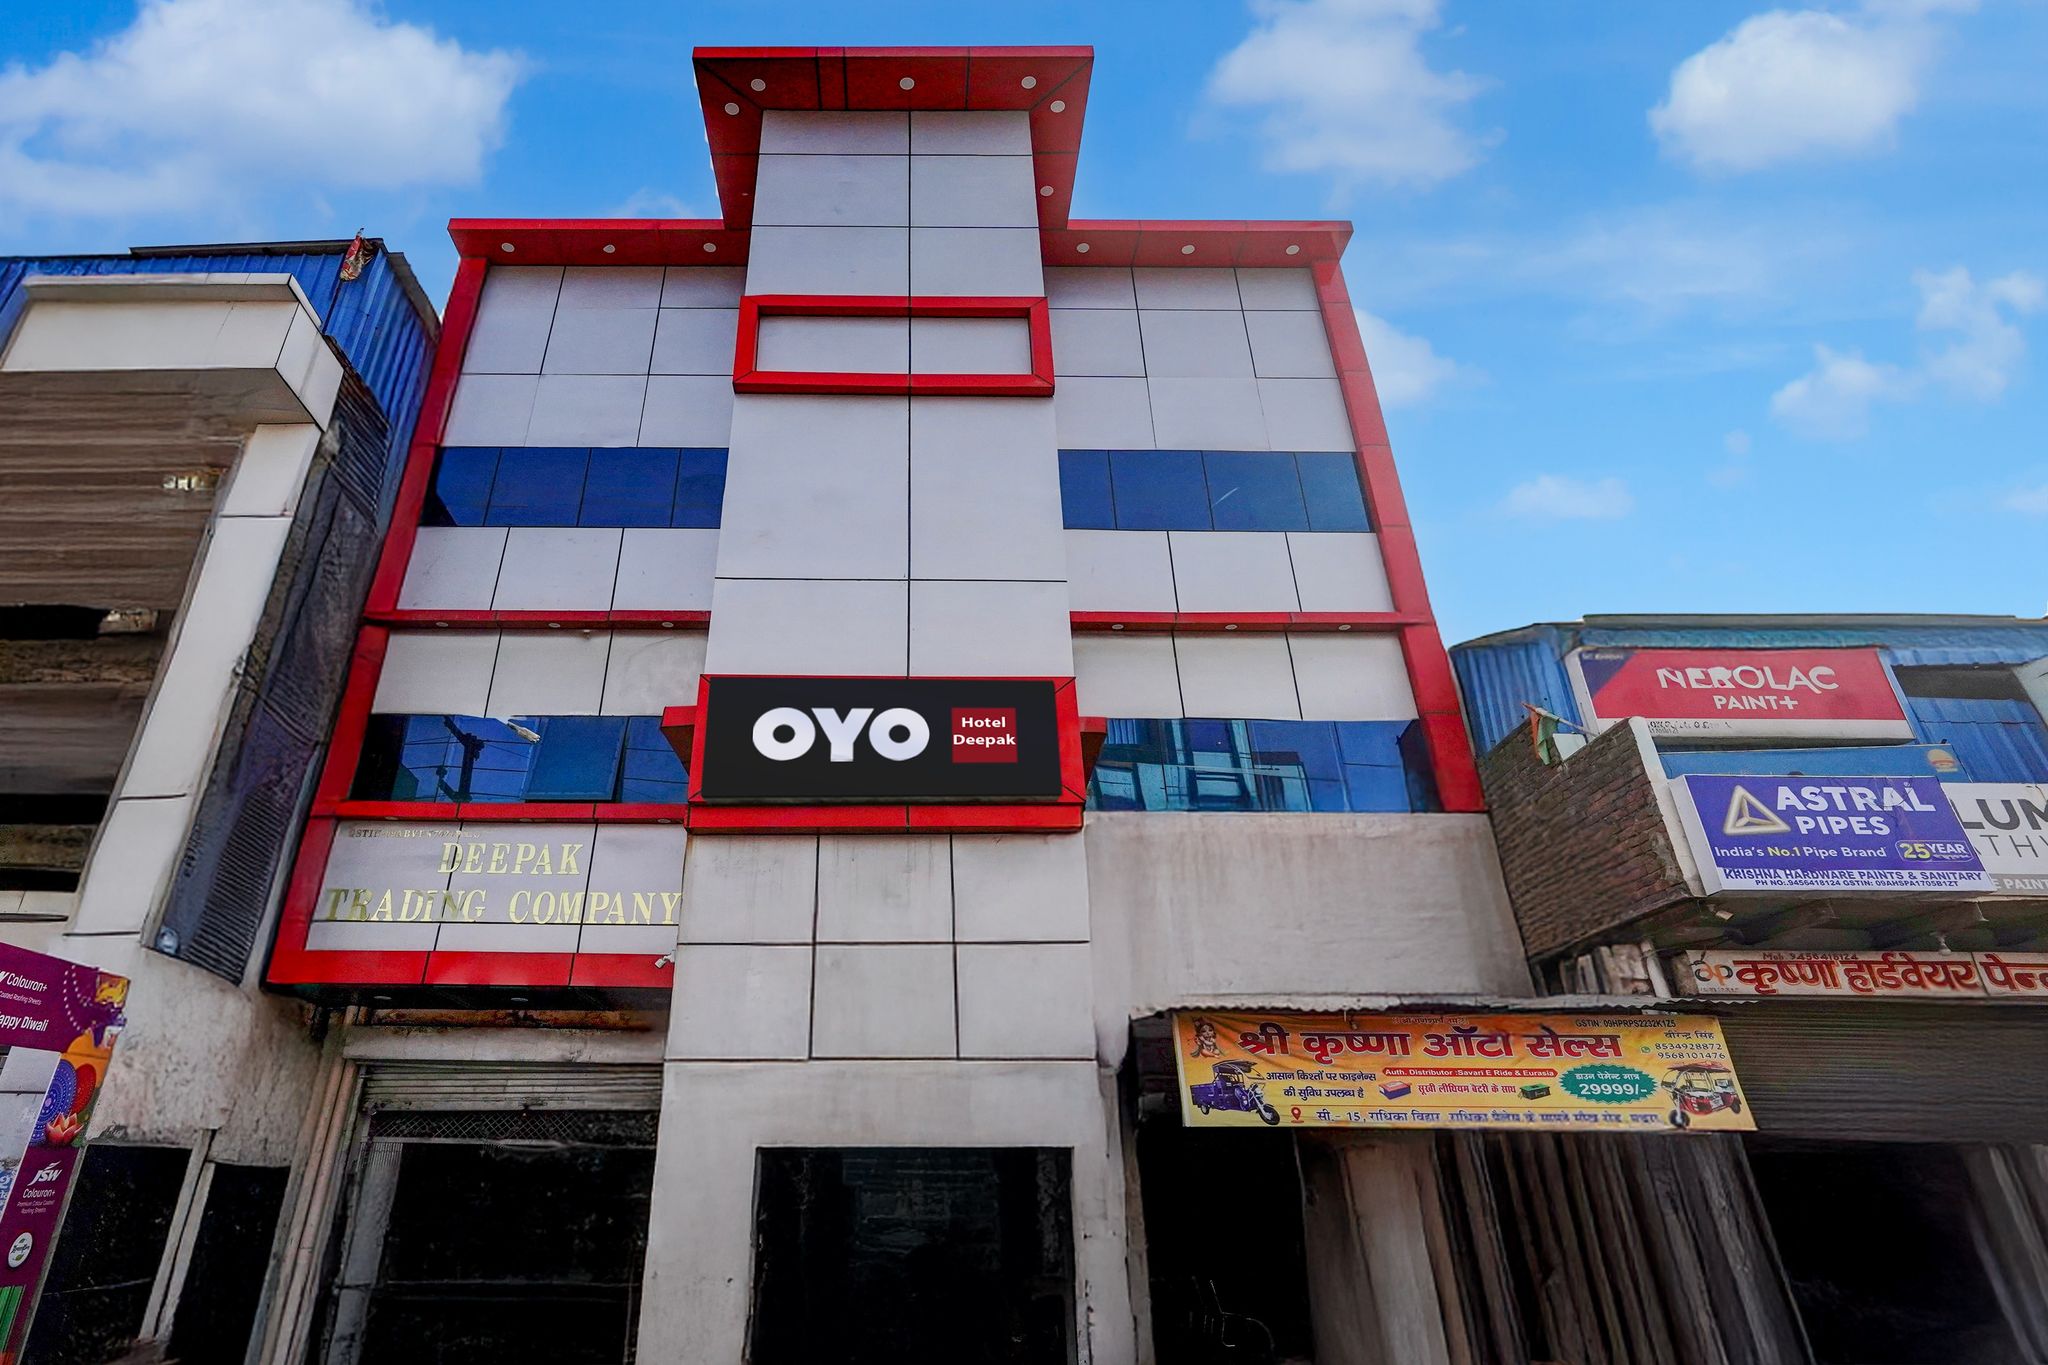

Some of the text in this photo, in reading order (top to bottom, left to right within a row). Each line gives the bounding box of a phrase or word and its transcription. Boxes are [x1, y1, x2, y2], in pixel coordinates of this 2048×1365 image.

[1656, 666, 1839, 693] NEROLAC
[1713, 695, 1798, 710] PAINT+
[961, 717, 1006, 728] Hotel
[752, 707, 930, 761] OYO
[953, 734, 1016, 748] Deepak
[1777, 786, 1936, 811] ASTRAL
[1795, 816, 1890, 835] PIPES
[1714, 846, 1883, 859] India's No.1 Pipe Brand
[1900, 842, 1931, 859] 25
[438, 843, 583, 875] DEEPAK
[1723, 868, 1982, 881] KRISHNA HARDWARE PAINTS & SANITARY
[509, 890, 682, 925] COMPANY
[7, 972, 48, 992] Colouron+
[1733, 960, 1841, 994] कृष्णा
[0, 1011, 49, 1032] appy Diwali
[1238, 1022, 1290, 1055] श्री
[1300, 1032, 1411, 1065] कृष्णा
[1522, 1024, 1622, 1058] सेल्स
[1655, 1042, 1723, 1051] 8534928872
[1657, 1051, 1726, 1060] 9568101476
[1266, 1072, 1295, 1081] आसान
[1297, 1069, 1324, 1081] किश्तों
[1325, 1072, 1337, 1081] पर
[1410, 1069, 1453, 1077] Distributor
[1486, 1069, 1492, 1077] E
[1494, 1069, 1513, 1077] Ride
[1523, 1069, 1554, 1077] Eurasia
[1283, 1085, 1296, 1097] की
[1357, 1086, 1365, 1098] है
[1579, 1083, 1648, 1095] 29999/-
[1368, 1109, 1408, 1121] राधिका
[27, 1168, 62, 1186] JSW
[22, 1187, 56, 1199] Colouron+
